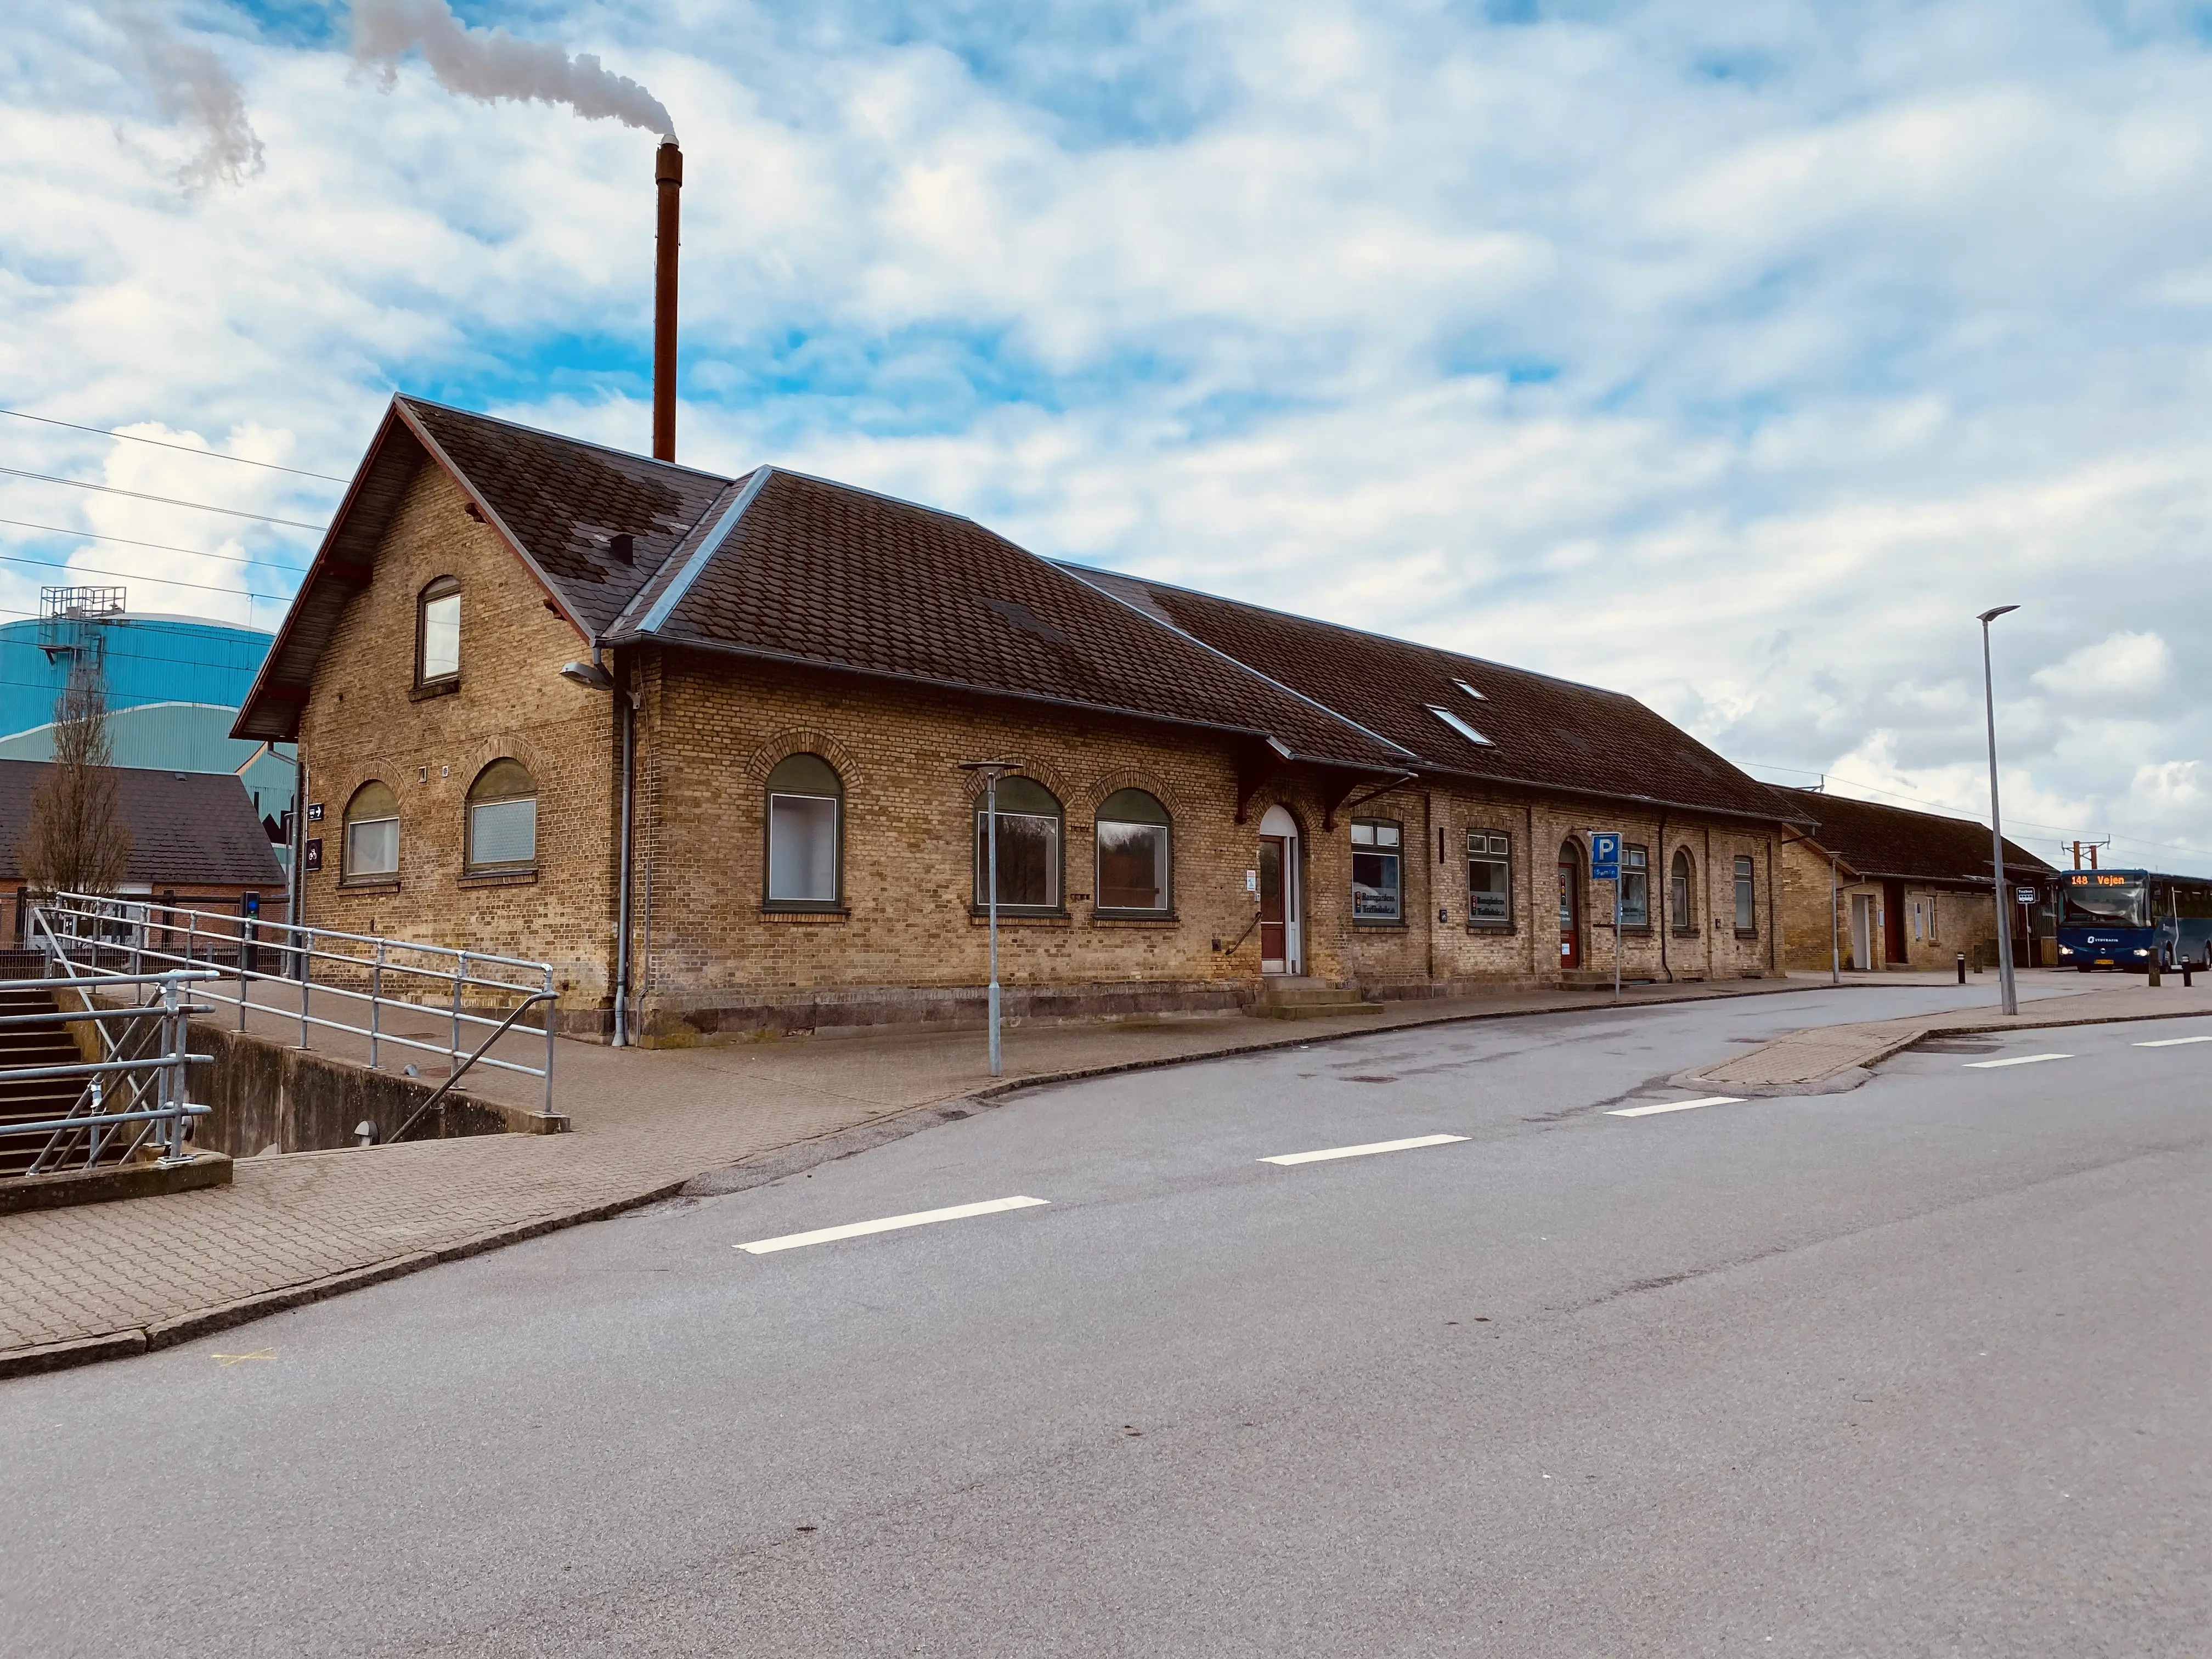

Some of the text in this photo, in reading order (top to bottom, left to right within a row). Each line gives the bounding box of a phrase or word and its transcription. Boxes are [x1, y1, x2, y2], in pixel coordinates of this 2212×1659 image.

[1599, 839, 1614, 860] P
[2072, 875, 2125, 887] 148 Vejen
